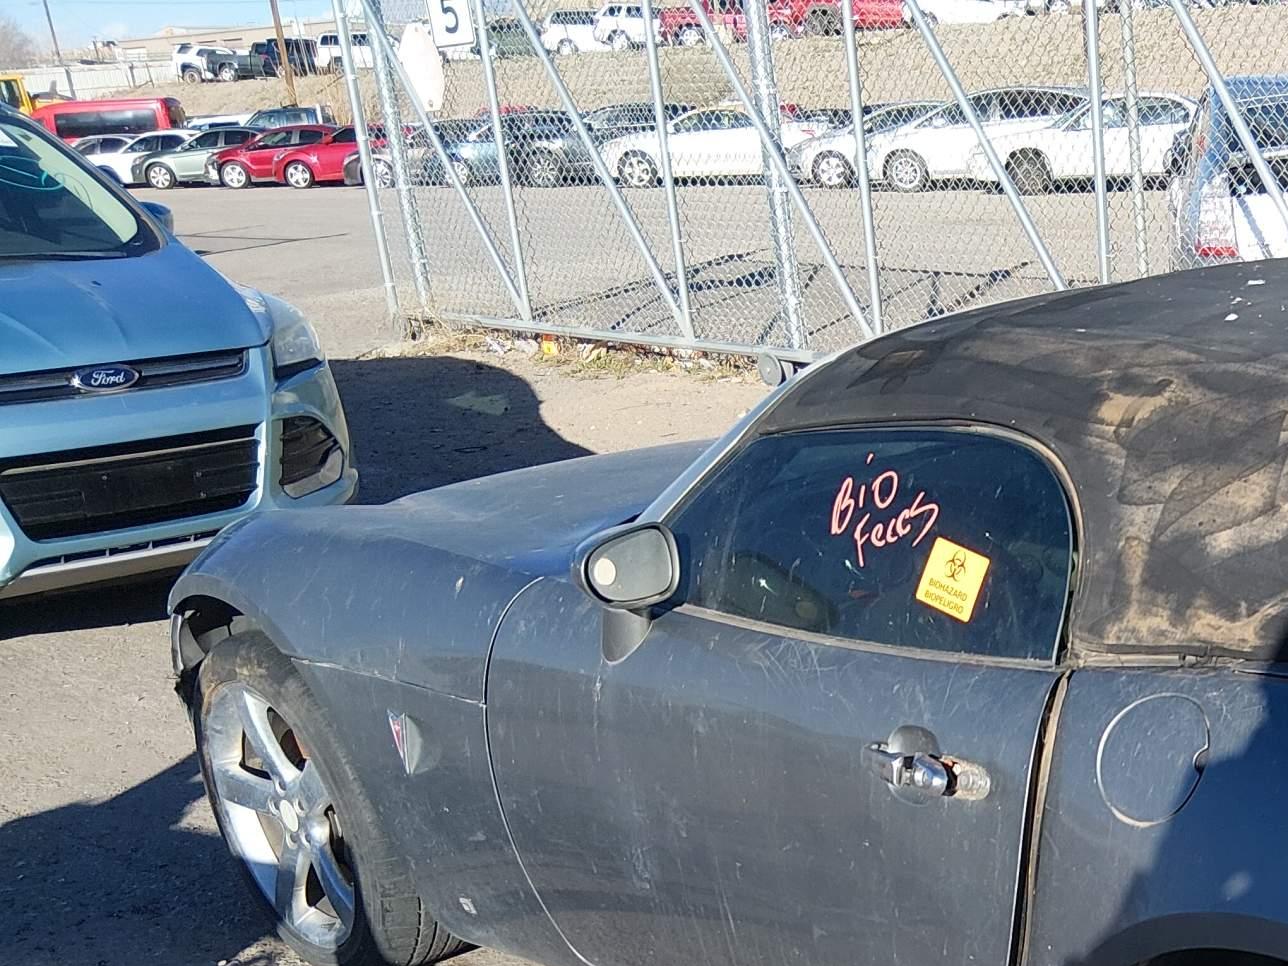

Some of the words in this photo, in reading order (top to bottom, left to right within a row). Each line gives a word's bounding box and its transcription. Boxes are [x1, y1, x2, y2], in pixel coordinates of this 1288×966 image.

[441, 0, 459, 34] 5
[91, 369, 126, 386] Ford
[924, 589, 964, 614] BIOPELIGRO
[928, 577, 968, 602] BIOHAZARD
